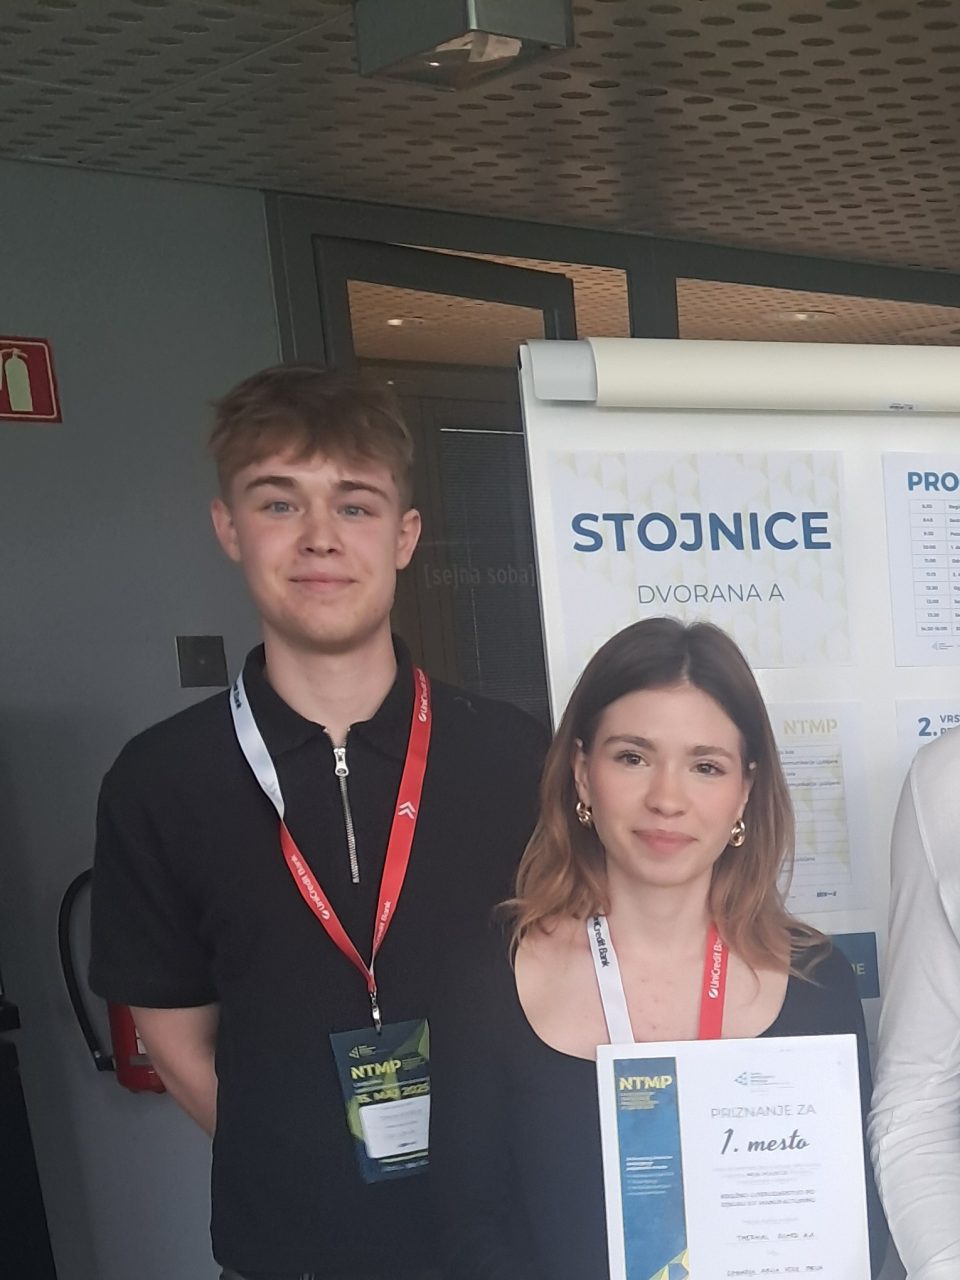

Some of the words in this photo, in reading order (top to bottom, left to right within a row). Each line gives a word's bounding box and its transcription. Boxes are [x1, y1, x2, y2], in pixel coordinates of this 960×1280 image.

[571, 512, 832, 553] STOJNICE
[638, 583, 763, 604] DVORANA
[768, 582, 784, 602] A
[783, 718, 838, 735] NTMP
[917, 716, 938, 737] 2.
[710, 951, 722, 988] UniCredit
[351, 1058, 402, 1079] NTMP
[619, 1075, 673, 1091] NTMP
[711, 1104, 793, 1118] PRIZNANJE
[797, 1103, 817, 1116] ZA
[720, 1127, 739, 1155] 1.
[747, 1128, 811, 1153] mesto
